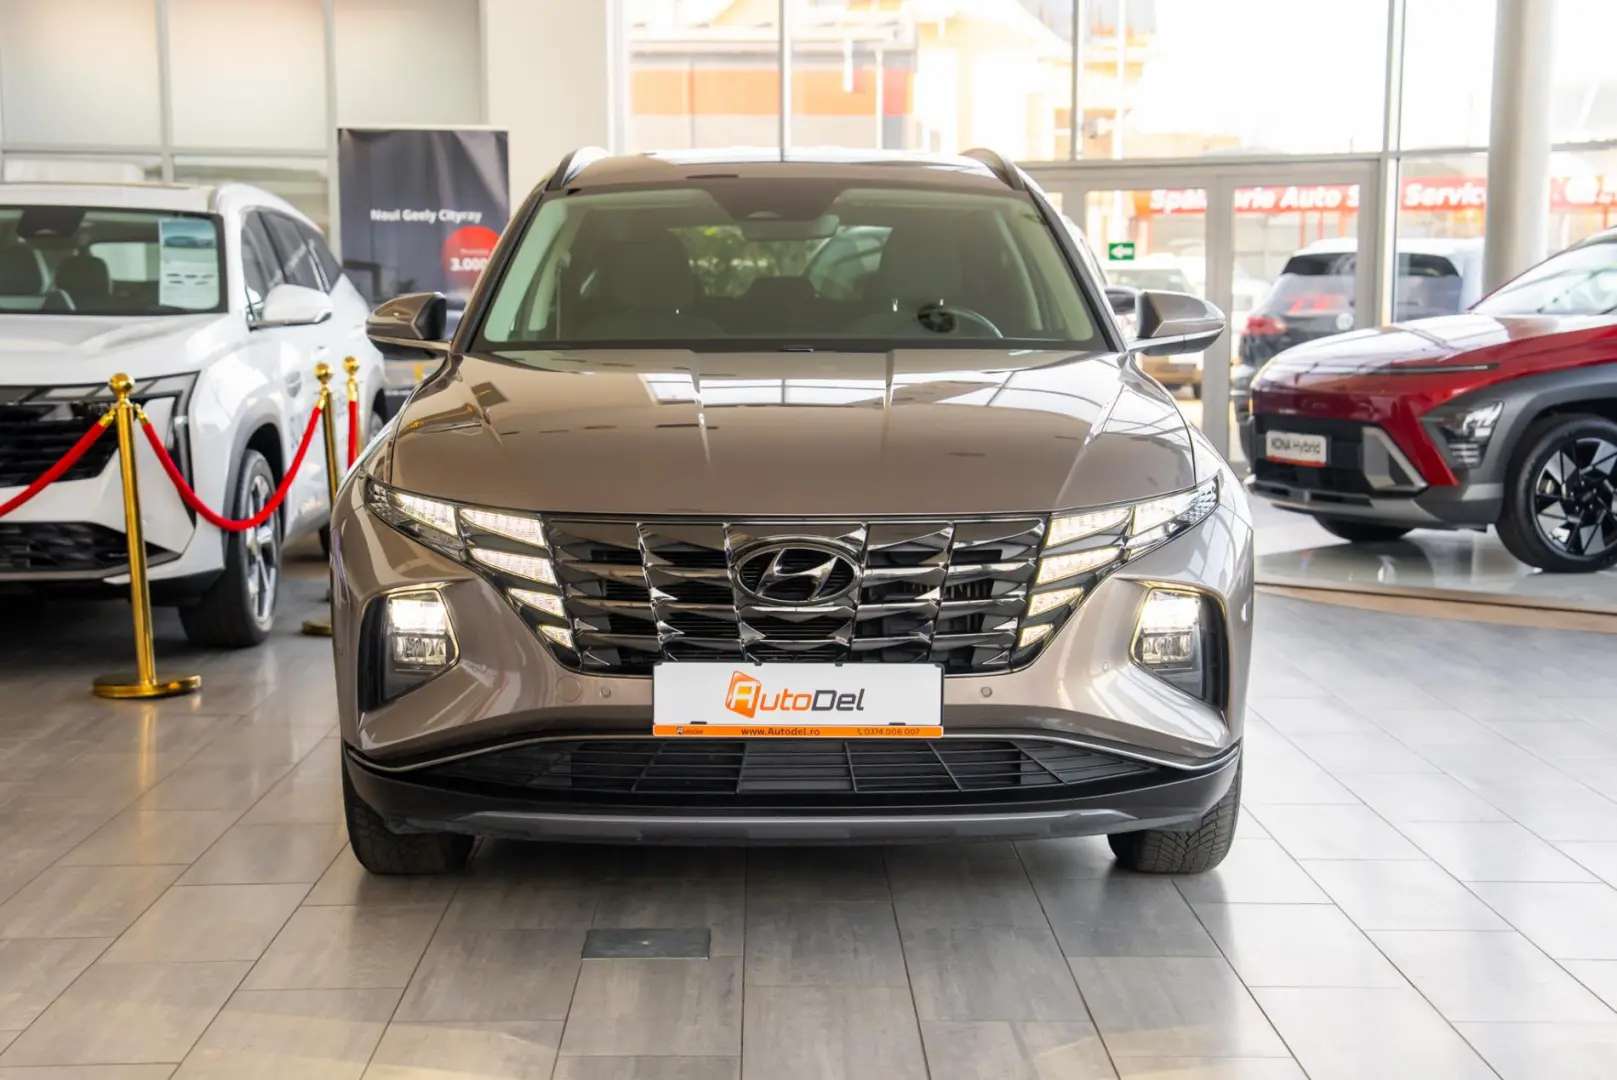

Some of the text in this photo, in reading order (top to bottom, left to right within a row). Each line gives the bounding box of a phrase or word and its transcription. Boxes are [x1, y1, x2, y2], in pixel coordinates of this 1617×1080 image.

[1279, 186, 1342, 209] Auto
[1404, 181, 1487, 205] Servic
[370, 209, 482, 224] Noul Geely Cityray
[729, 680, 865, 712] AutoDel
[740, 726, 820, 737] www.Autodel.ro
